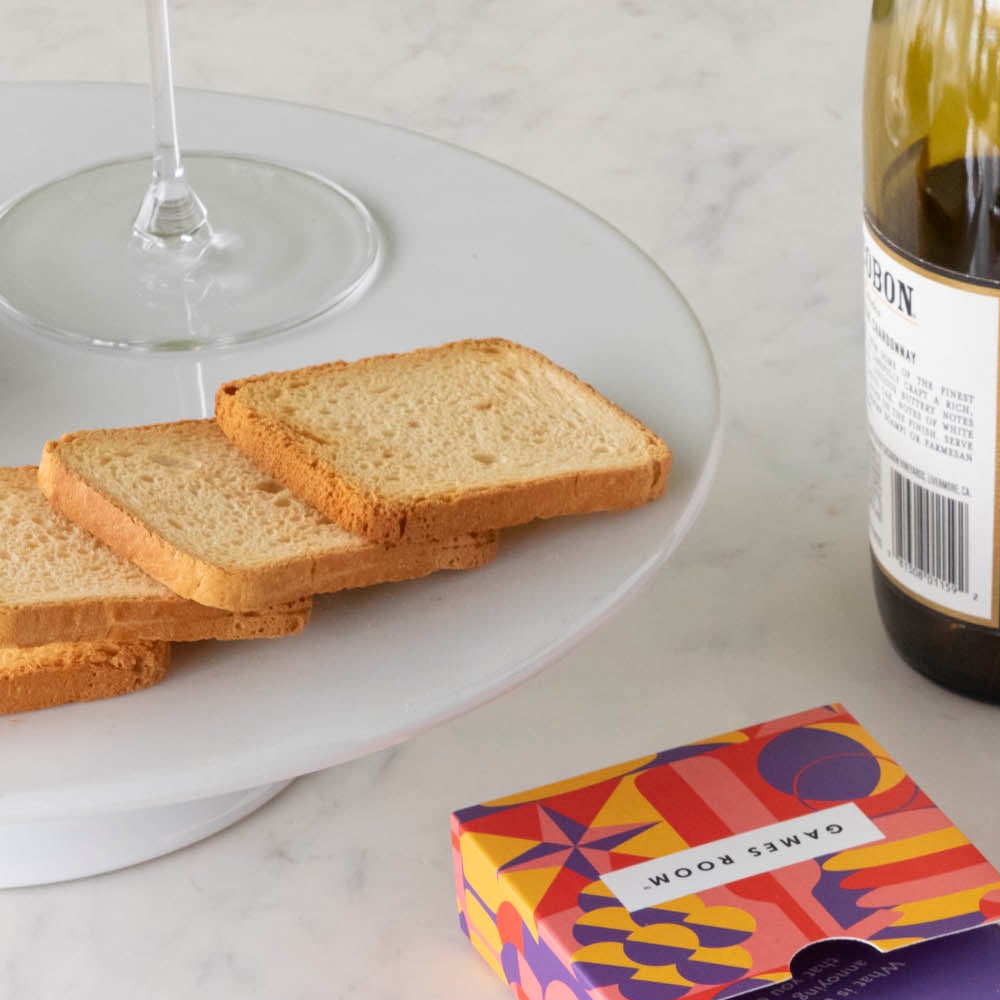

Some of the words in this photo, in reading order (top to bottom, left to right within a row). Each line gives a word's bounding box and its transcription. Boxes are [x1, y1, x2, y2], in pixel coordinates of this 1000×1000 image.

[940, 385, 975, 404] FINEST
[942, 410, 975, 428] NOTES
[941, 421, 974, 440] WHITE
[924, 439, 973, 463] PARMESAN
[944, 434, 973, 451] SERVE
[748, 824, 843, 857] GAMES
[802, 957, 839, 977] that
[854, 961, 906, 987] What
[769, 978, 803, 996] you
[792, 959, 867, 1000] annoying
[836, 987, 858, 998] is
